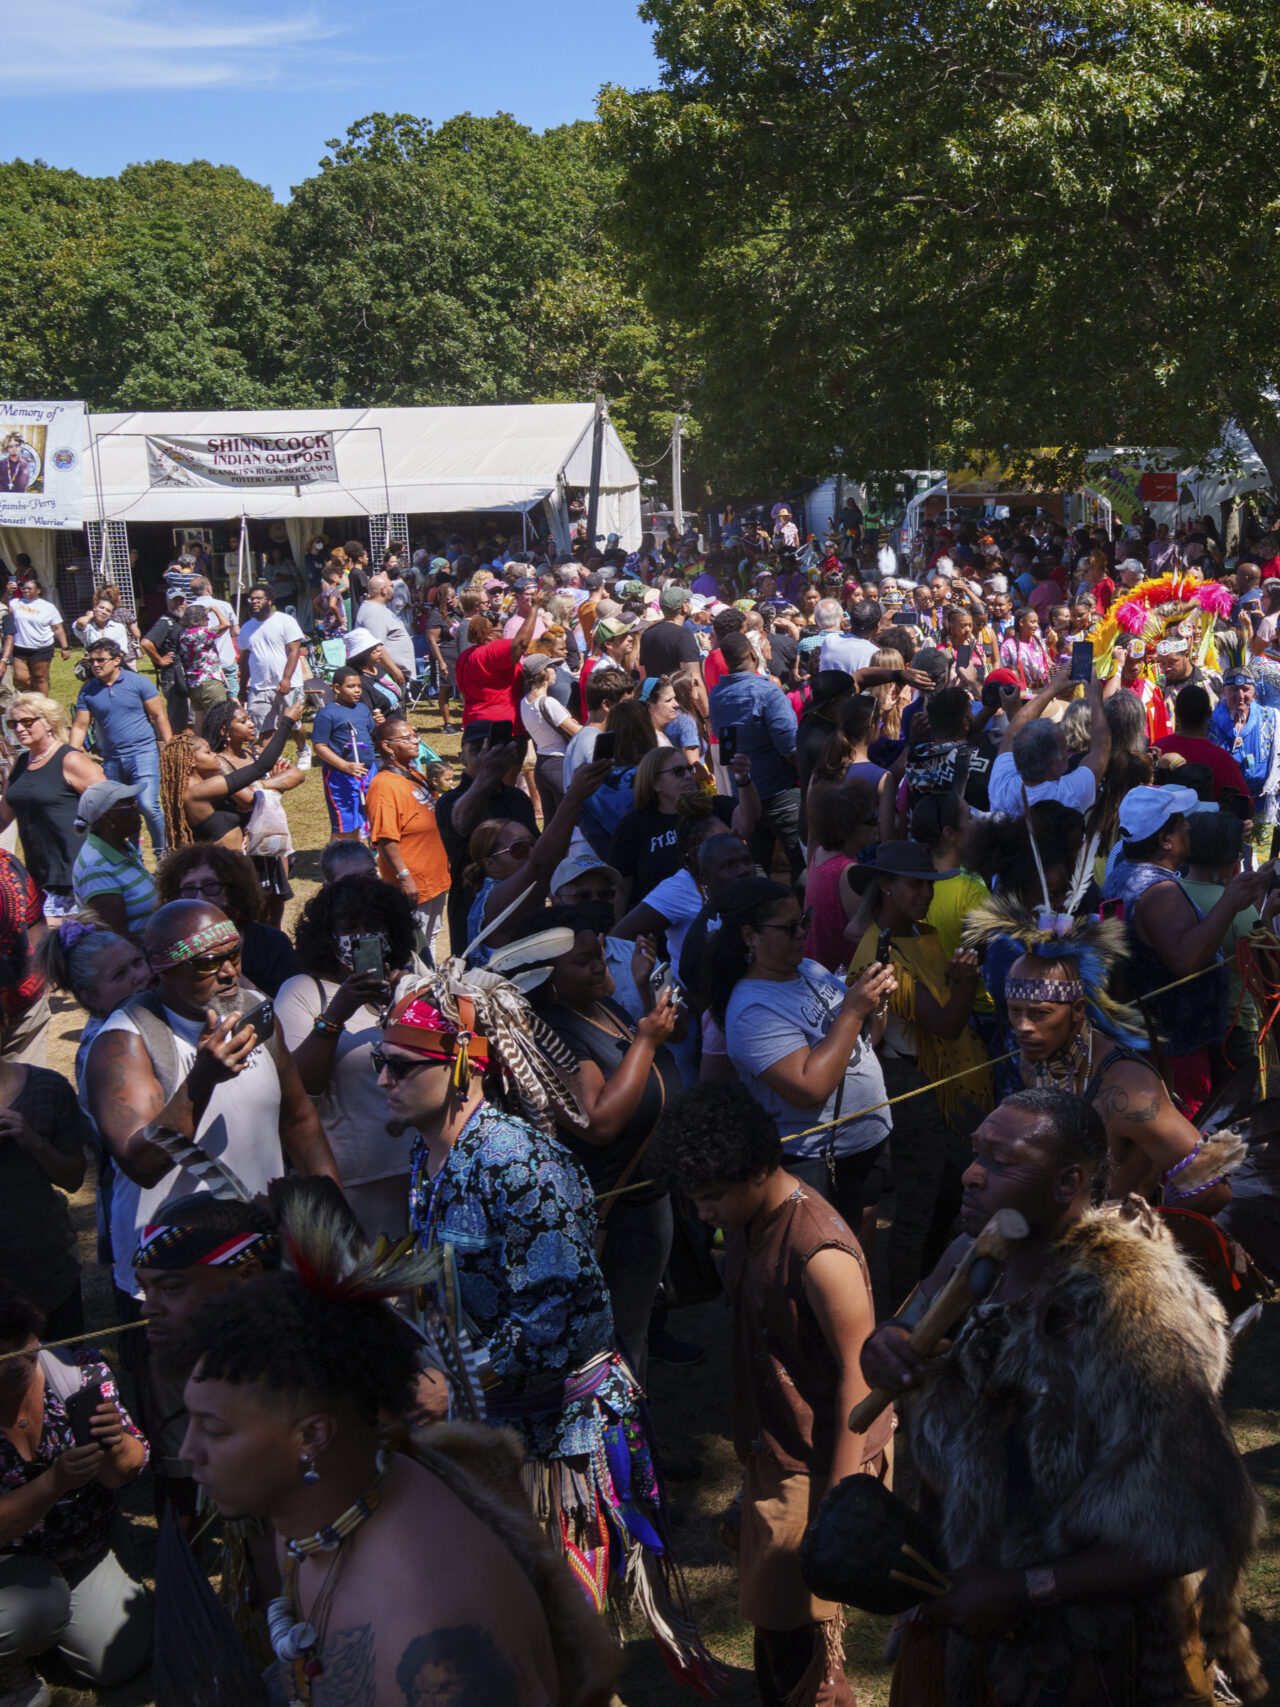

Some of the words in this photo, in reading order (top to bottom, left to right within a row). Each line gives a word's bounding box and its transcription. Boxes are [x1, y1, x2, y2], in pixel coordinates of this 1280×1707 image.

[207, 435, 328, 452] SHINNECOCK
[213, 454, 261, 465] INDIAN
[265, 451, 331, 465] OUTPOST
[285, 465, 333, 474] MOCCASINS
[274, 474, 311, 482] JEWELRY
